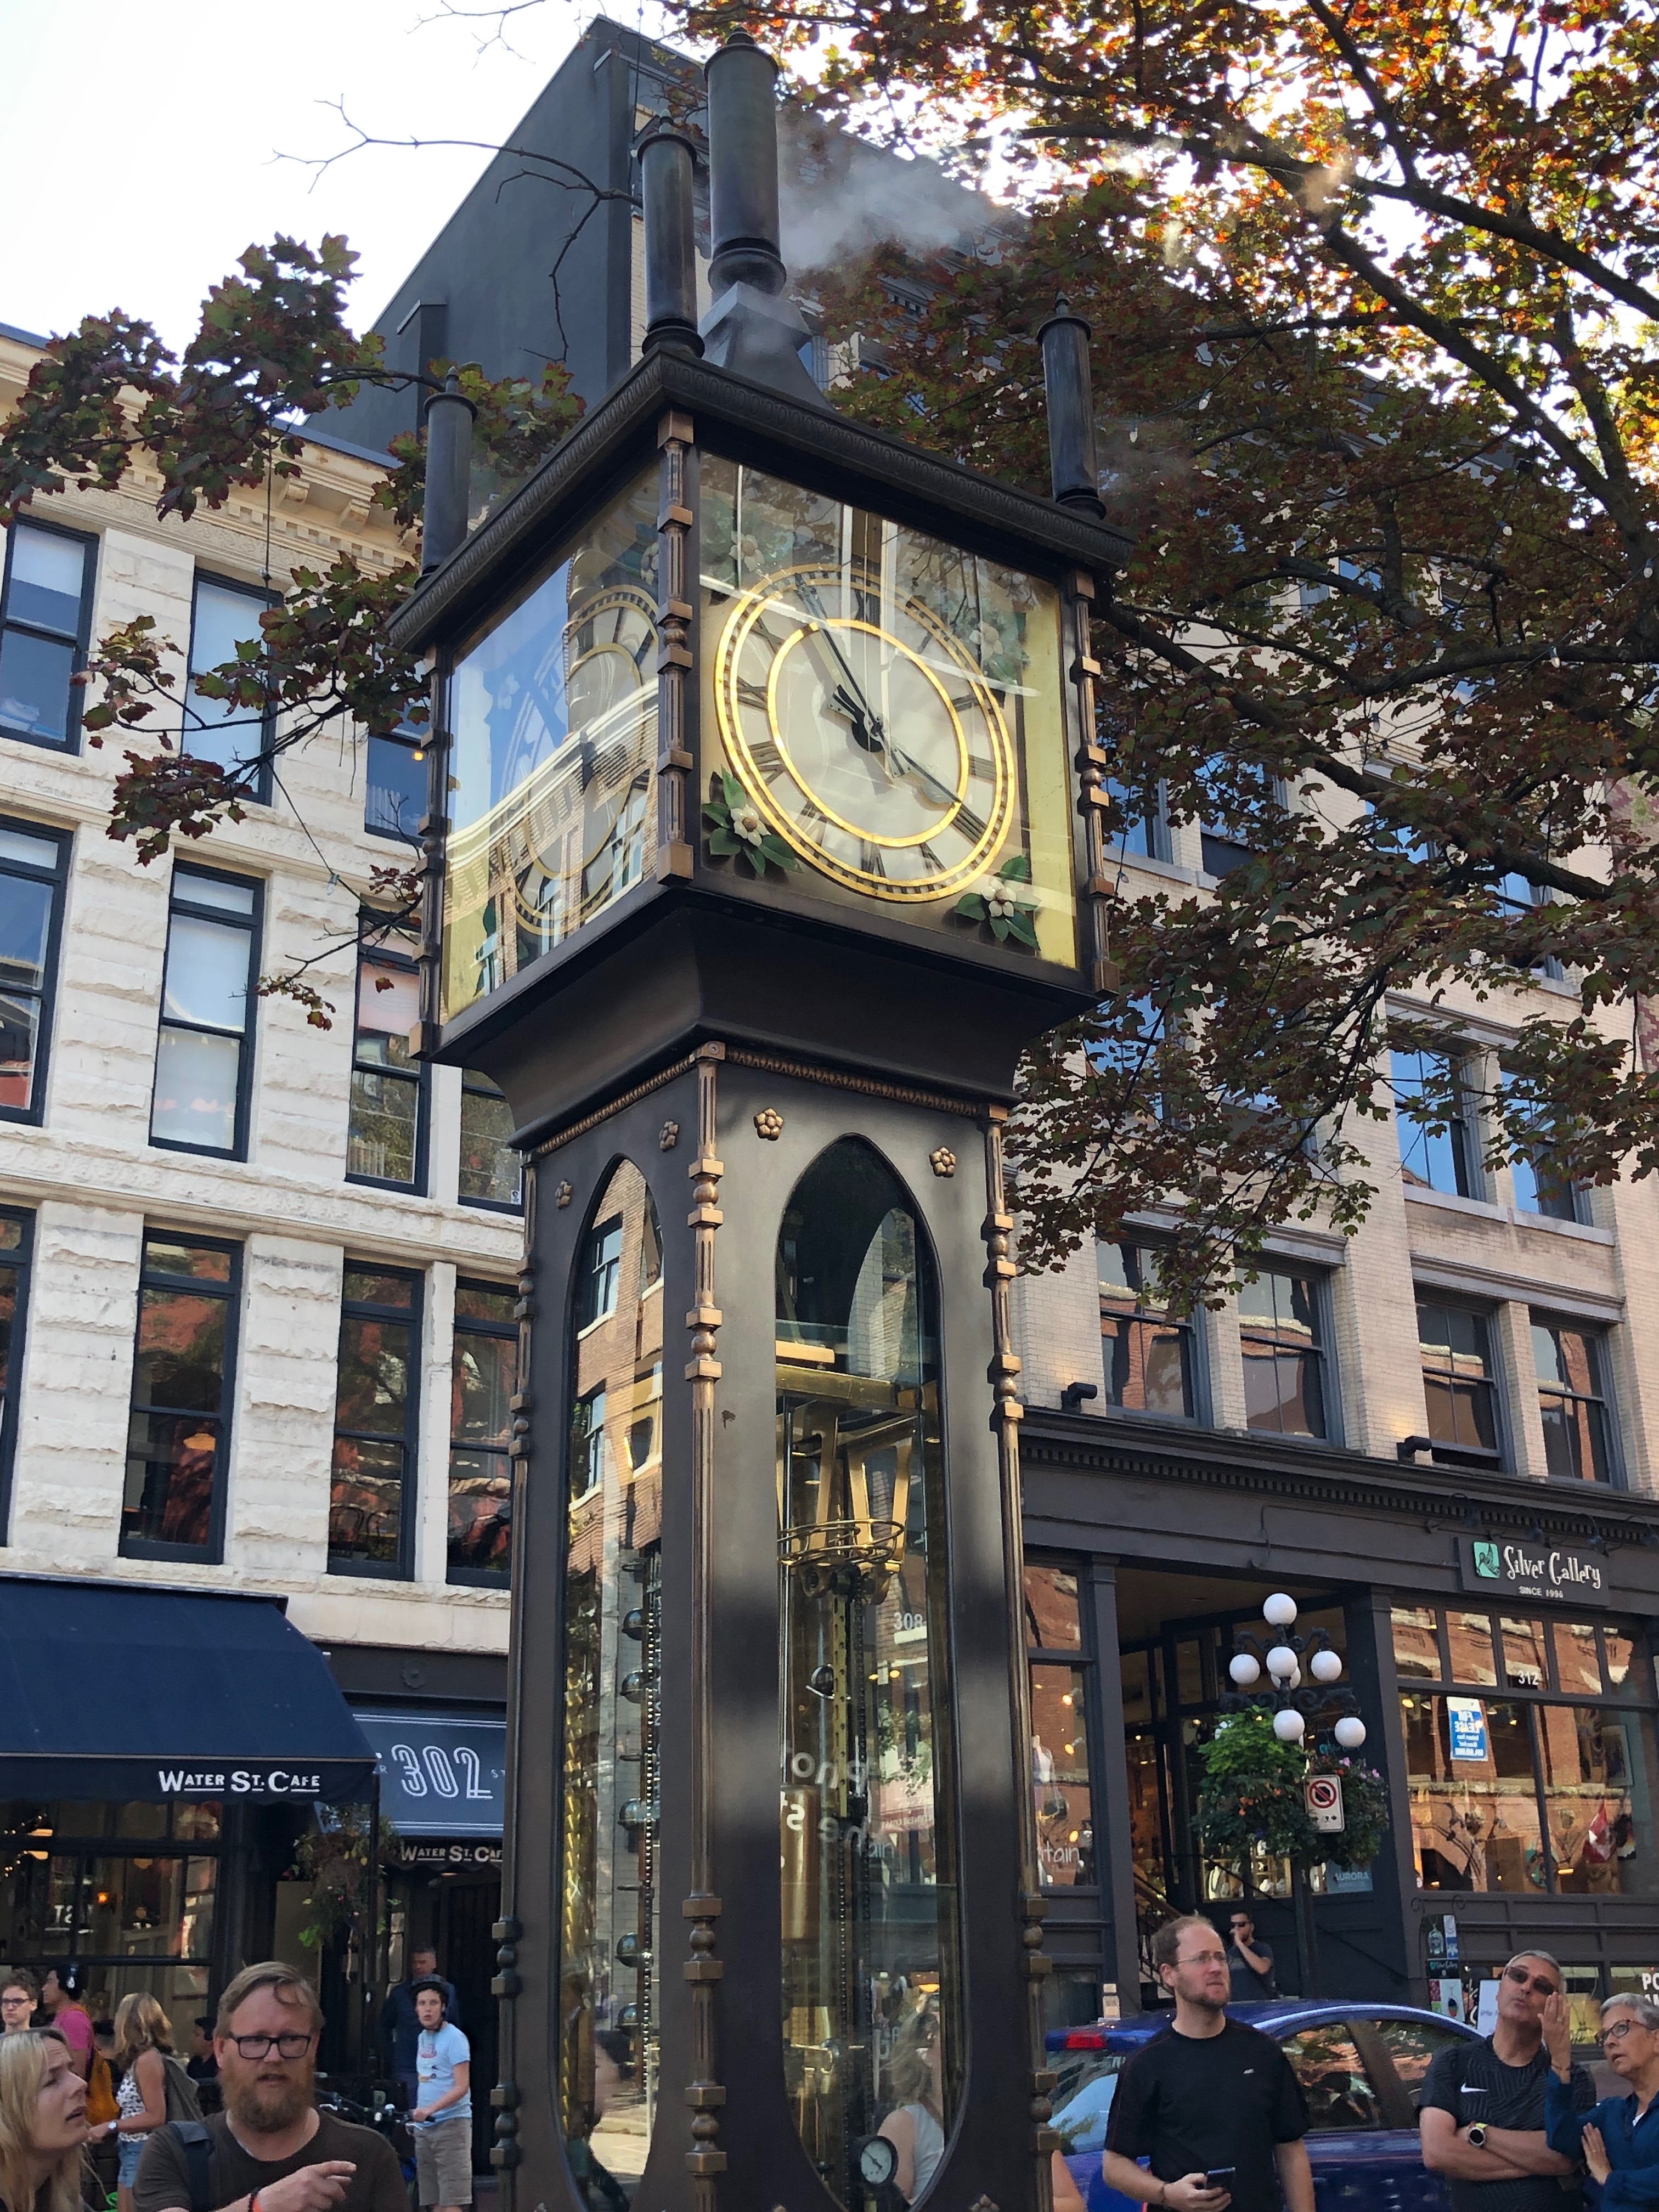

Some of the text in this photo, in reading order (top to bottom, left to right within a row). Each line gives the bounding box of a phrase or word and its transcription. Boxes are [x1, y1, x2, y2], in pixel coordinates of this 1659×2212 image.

[1503, 1545, 1601, 1589] Silver Gallery
[1519, 1585, 1542, 1596] SINCE
[893, 1612, 923, 1631] 308
[1517, 1669, 1539, 1686] 312
[159, 1770, 225, 1792] WATER
[391, 1743, 494, 1800] 302
